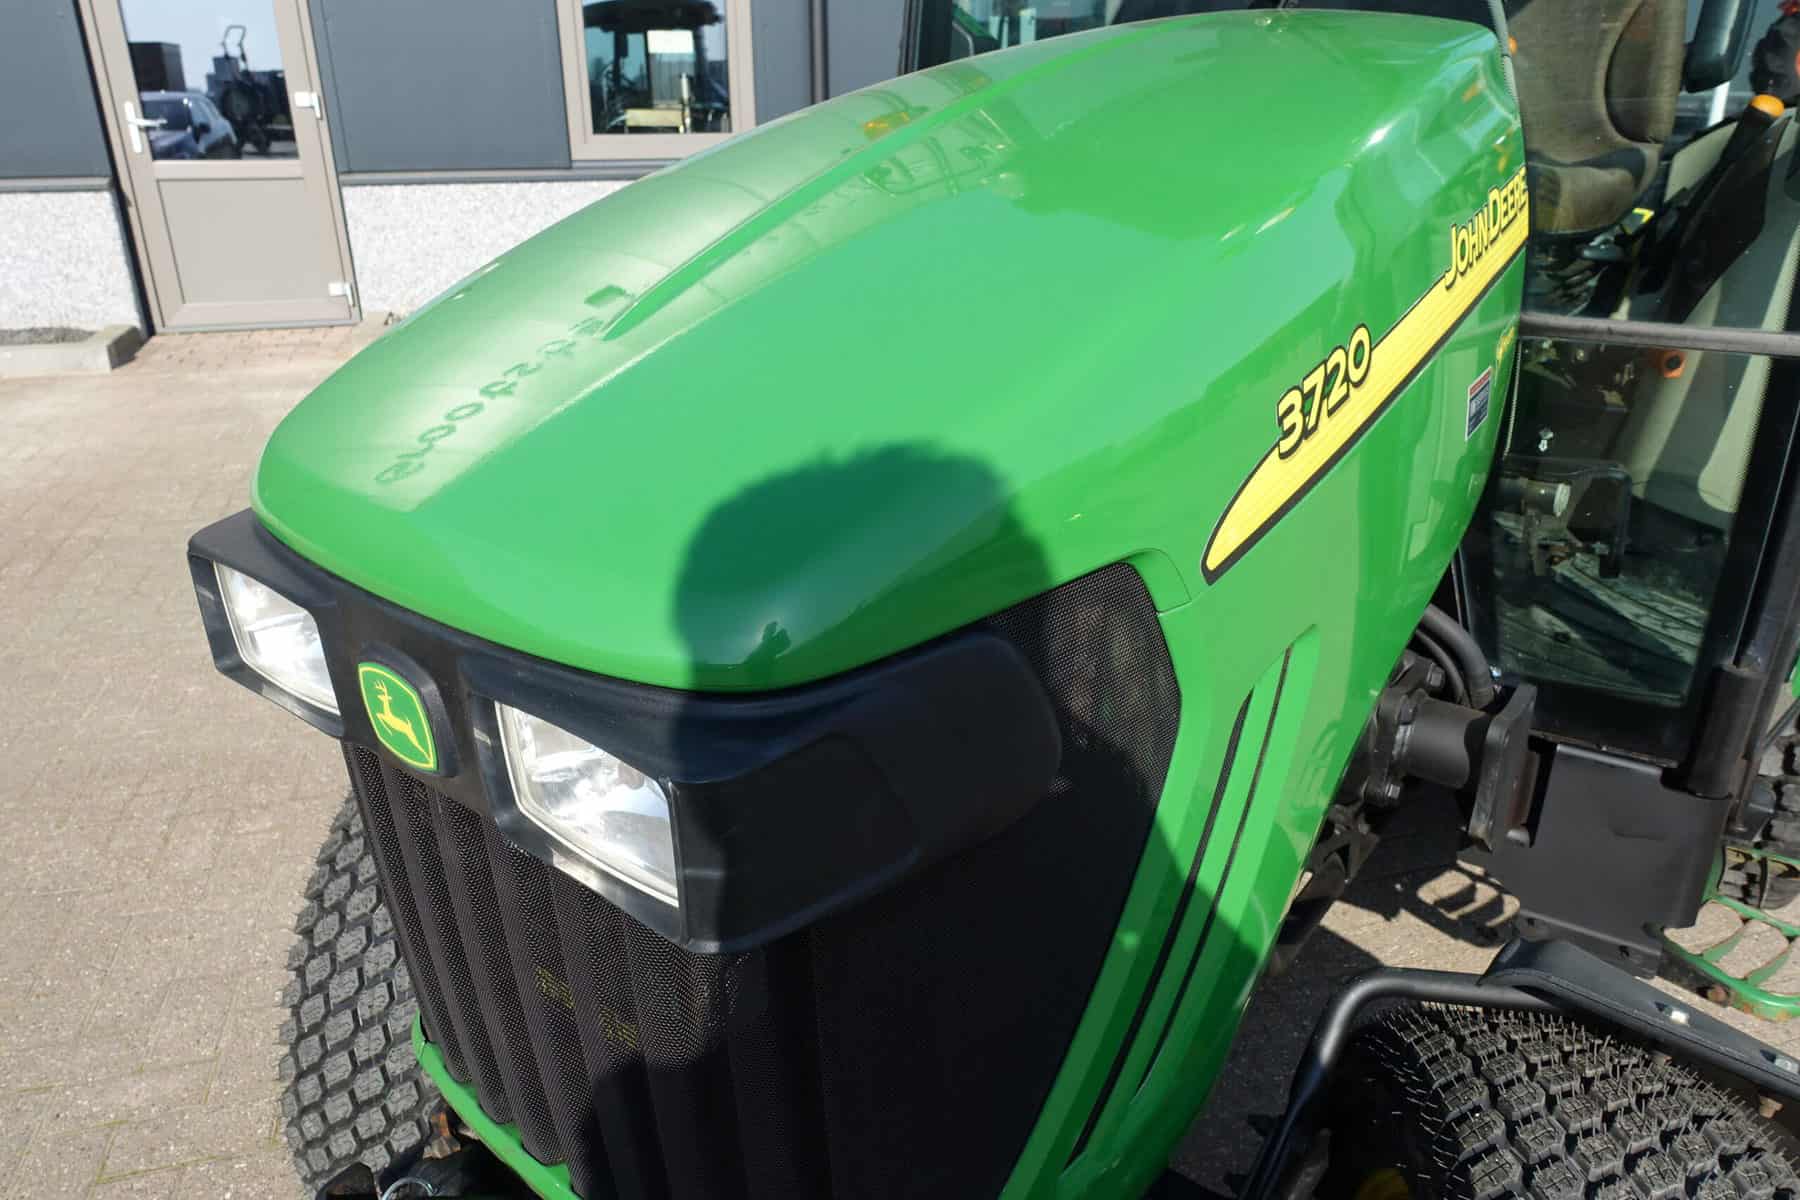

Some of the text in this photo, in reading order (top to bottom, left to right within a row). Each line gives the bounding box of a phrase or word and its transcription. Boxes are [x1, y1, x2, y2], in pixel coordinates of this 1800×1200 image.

[1444, 166, 1528, 290] JOHN DEERE
[1277, 323, 1371, 459] 3720
